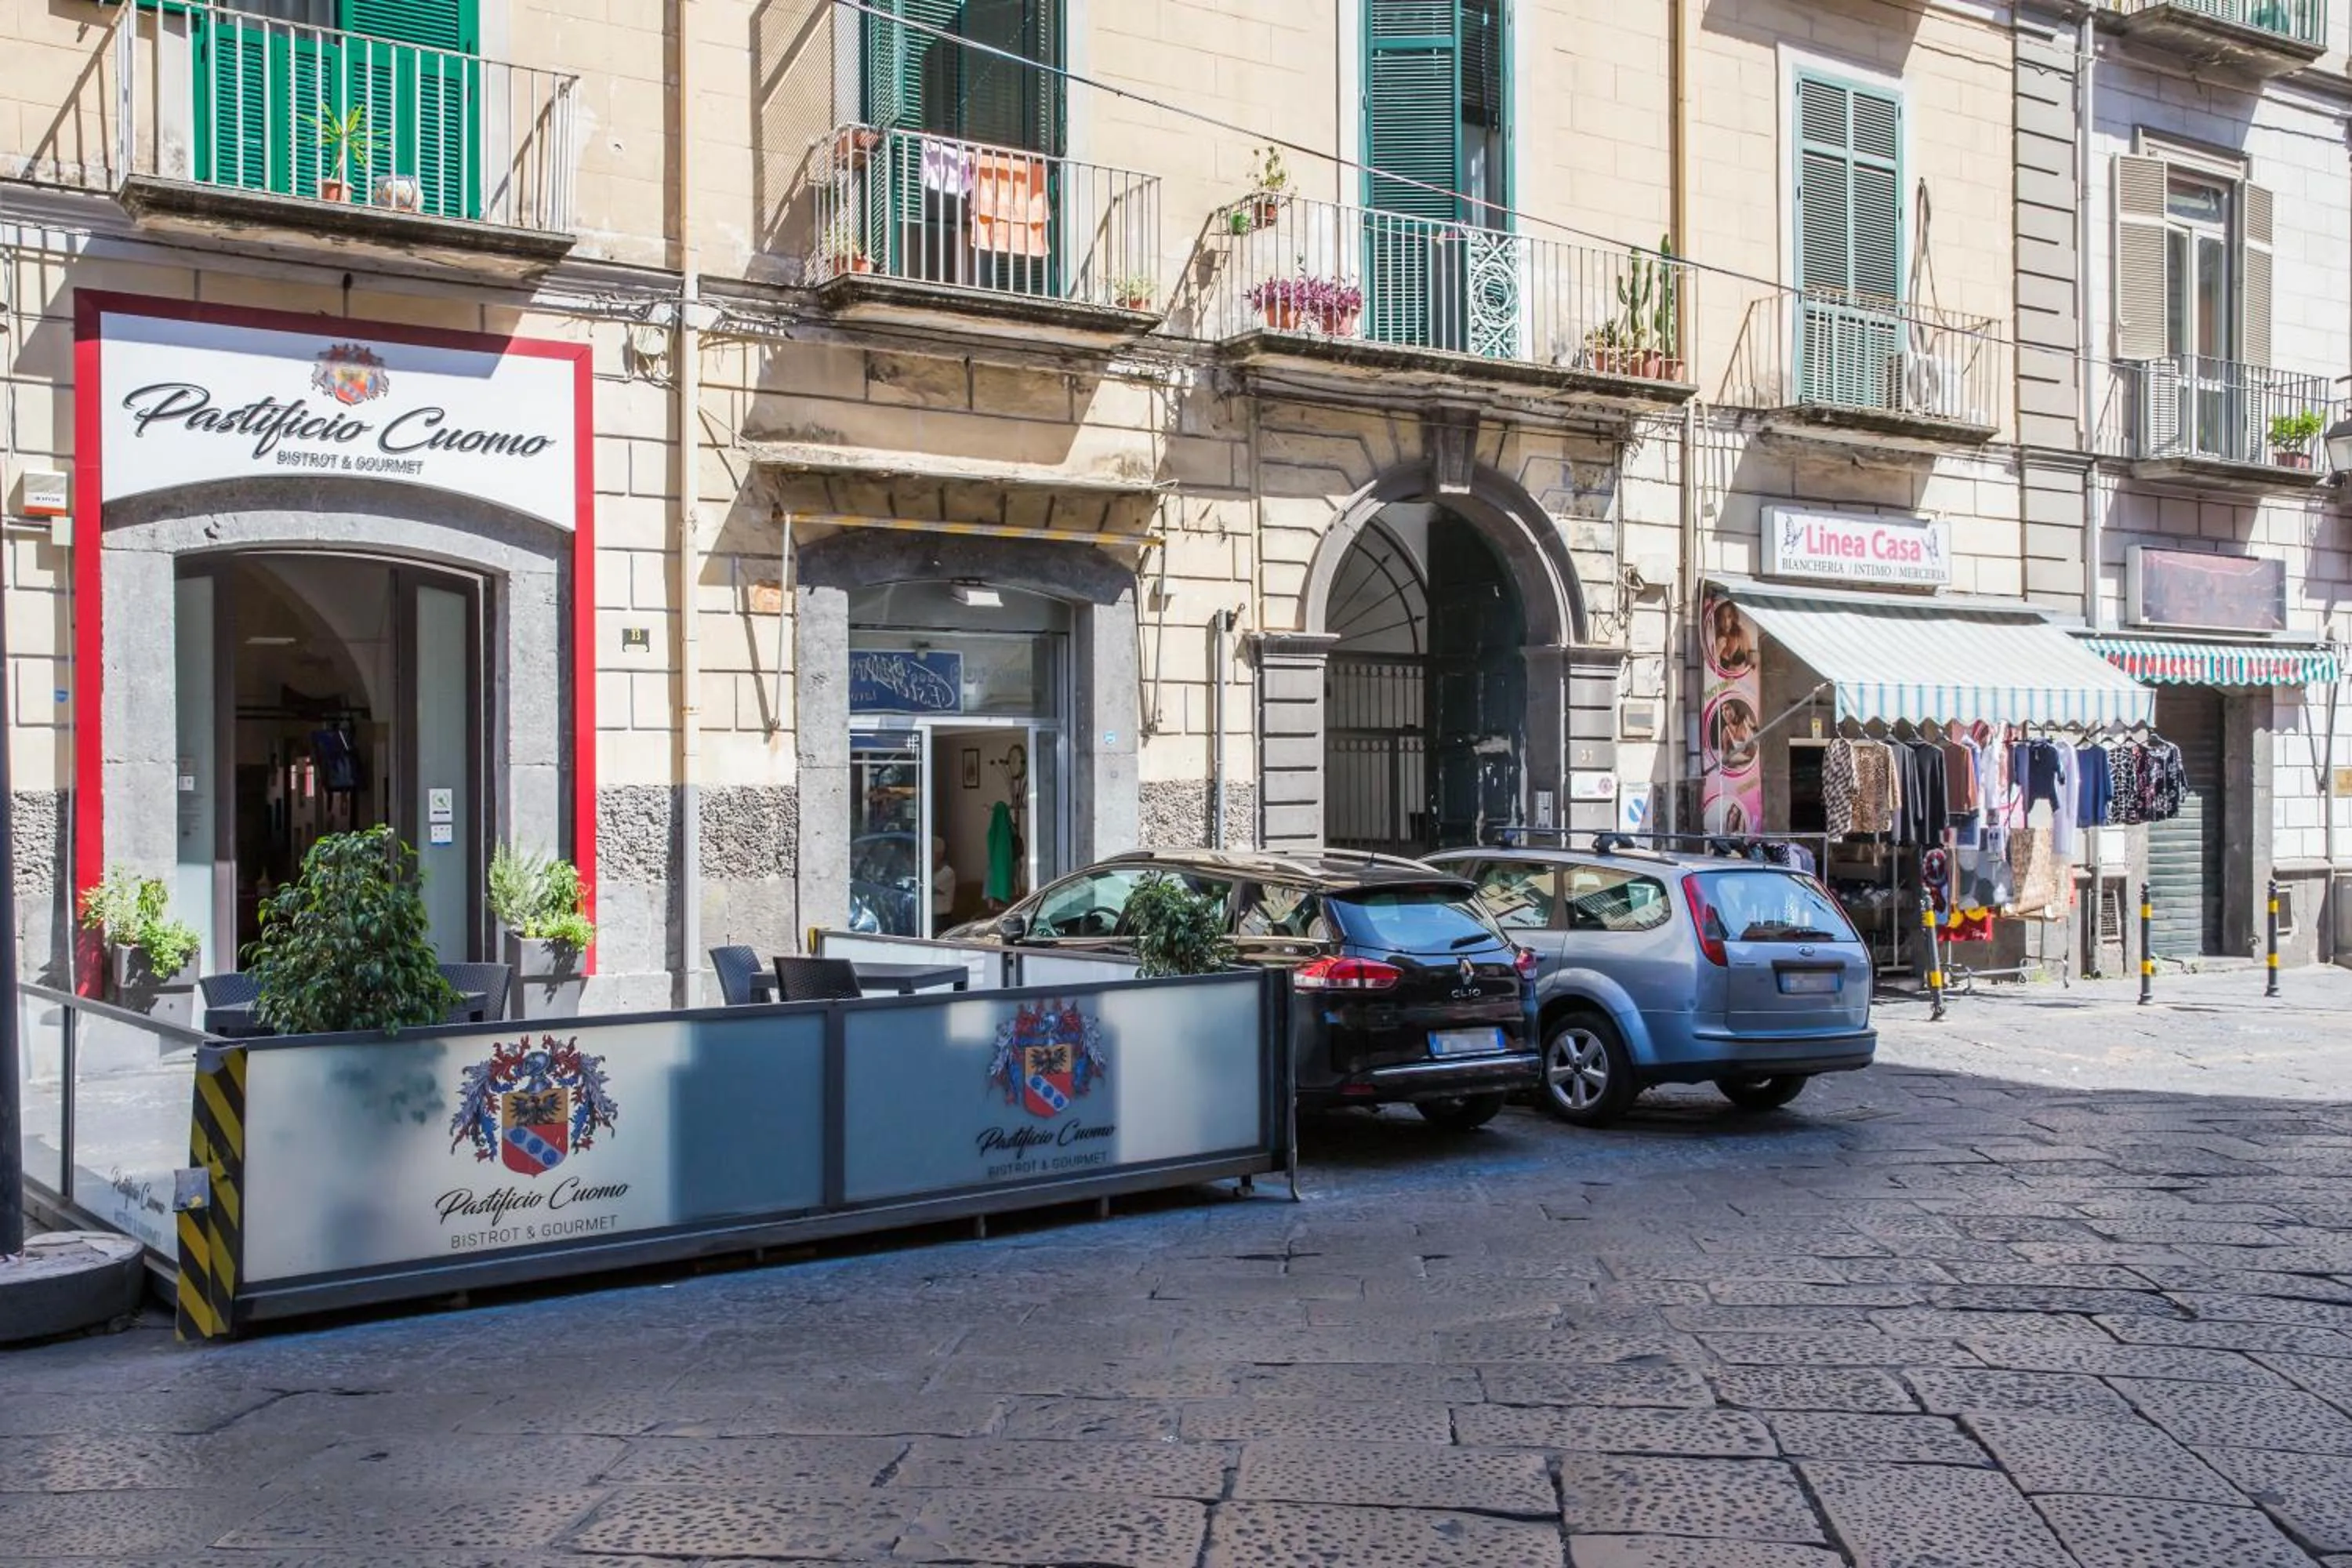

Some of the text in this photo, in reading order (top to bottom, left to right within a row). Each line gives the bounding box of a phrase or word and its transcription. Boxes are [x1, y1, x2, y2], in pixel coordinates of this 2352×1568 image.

[122, 382, 556, 459] Pastificio Cuomo
[276, 450, 424, 475] BISTROT & GOURMET
[1806, 524, 1922, 562] Linea Casa
[1781, 557, 1845, 574] BIANCHERIA
[1854, 564, 1892, 578] INTIMO
[1899, 568, 1947, 581] MERCERIA
[1451, 988, 1481, 998] CLIO
[977, 1117, 1116, 1160] Pastificio Cuomo
[435, 1176, 630, 1227] Pastificio Cuomo
[526, 1226, 536, 1240] &
[541, 1214, 619, 1237] GOURMET
